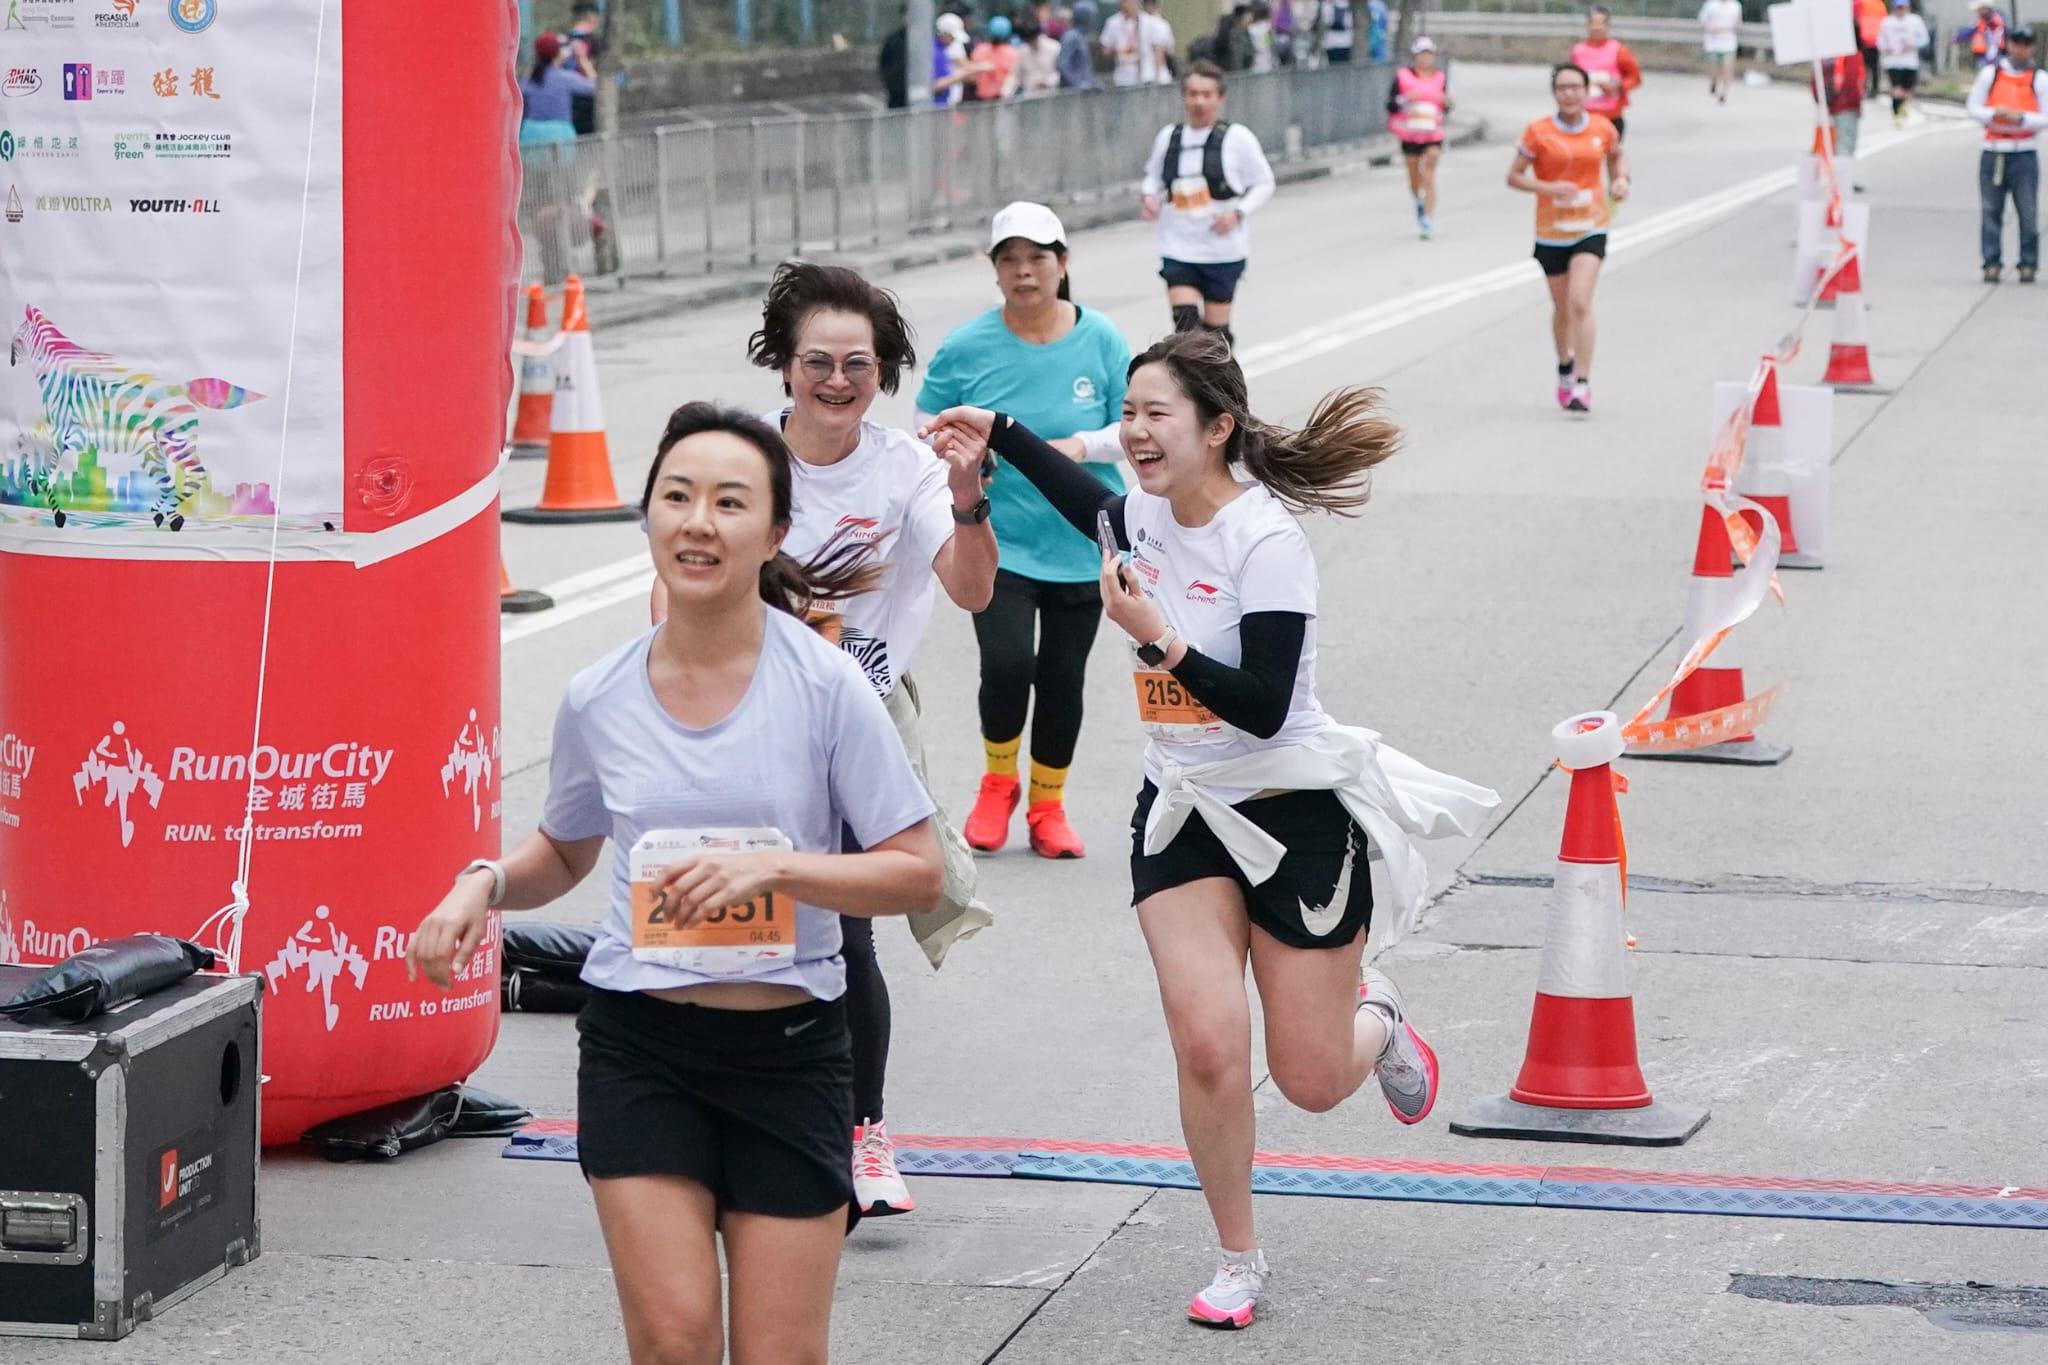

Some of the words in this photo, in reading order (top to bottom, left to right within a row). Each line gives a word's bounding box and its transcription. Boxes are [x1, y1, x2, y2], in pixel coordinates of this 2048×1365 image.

[114, 142, 127, 151] go
[114, 151, 144, 160] green
[63, 196, 112, 211] VOLTRA
[1144, 679, 1202, 707] 2151
[168, 742, 394, 786] RunOurCity
[245, 782, 367, 812] 全城街馬
[164, 824, 216, 841] RUN.
[256, 821, 363, 840] transform
[749, 931, 782, 943] 04:45
[369, 1001, 414, 1021] RUN.
[420, 1000, 437, 1016] to
[179, 1154, 213, 1182] PRODUCTION
[179, 1179, 193, 1198] UNIT
